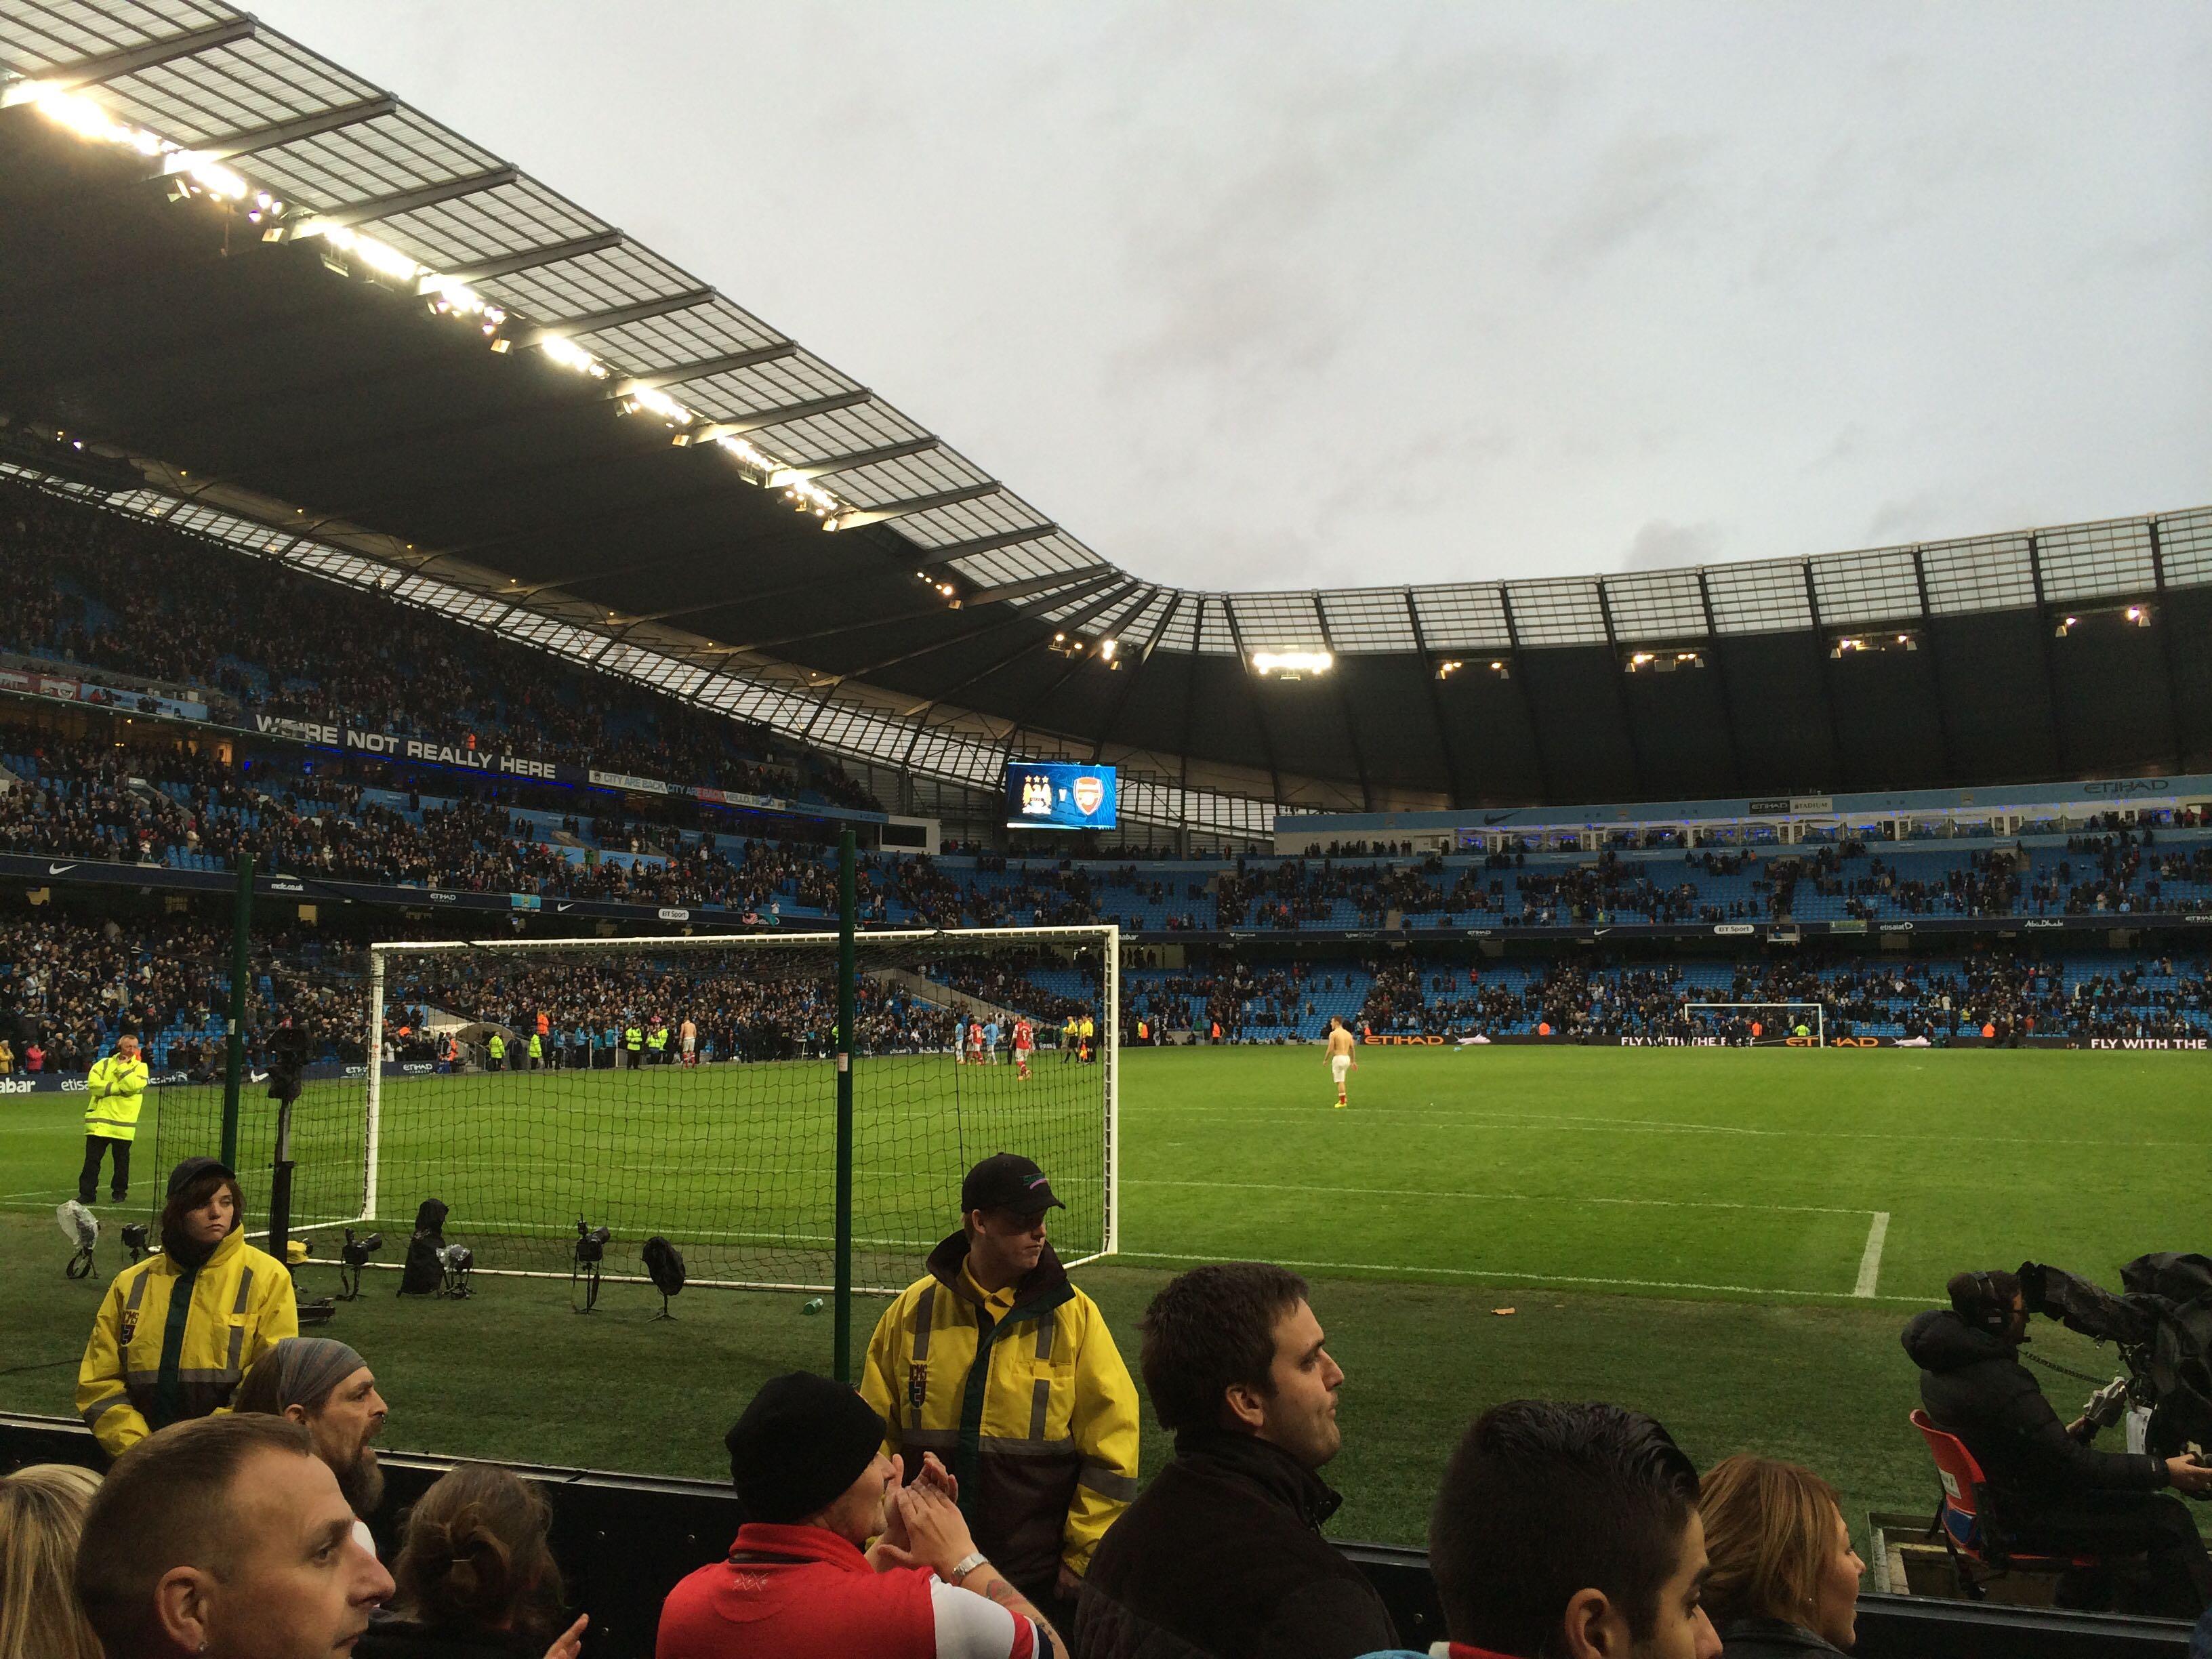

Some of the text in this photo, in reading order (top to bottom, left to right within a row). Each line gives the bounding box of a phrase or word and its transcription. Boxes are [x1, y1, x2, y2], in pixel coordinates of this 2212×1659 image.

[347, 729, 399, 754] NOT
[407, 740, 493, 769] REALLY
[500, 756, 556, 779] HERE
[2083, 780, 2169, 794] ETIHAD
[1795, 802, 1828, 810] STADIUM
[430, 893, 456, 901] ETIHAD
[1364, 1036, 1444, 1045] ETIHAD
[1621, 1036, 1643, 1046] FLY
[1786, 1037, 1879, 1047] ETHAD
[2091, 1038, 2208, 1050] FLY WITH THE
[403, 1063, 433, 1071] ETIHAD
